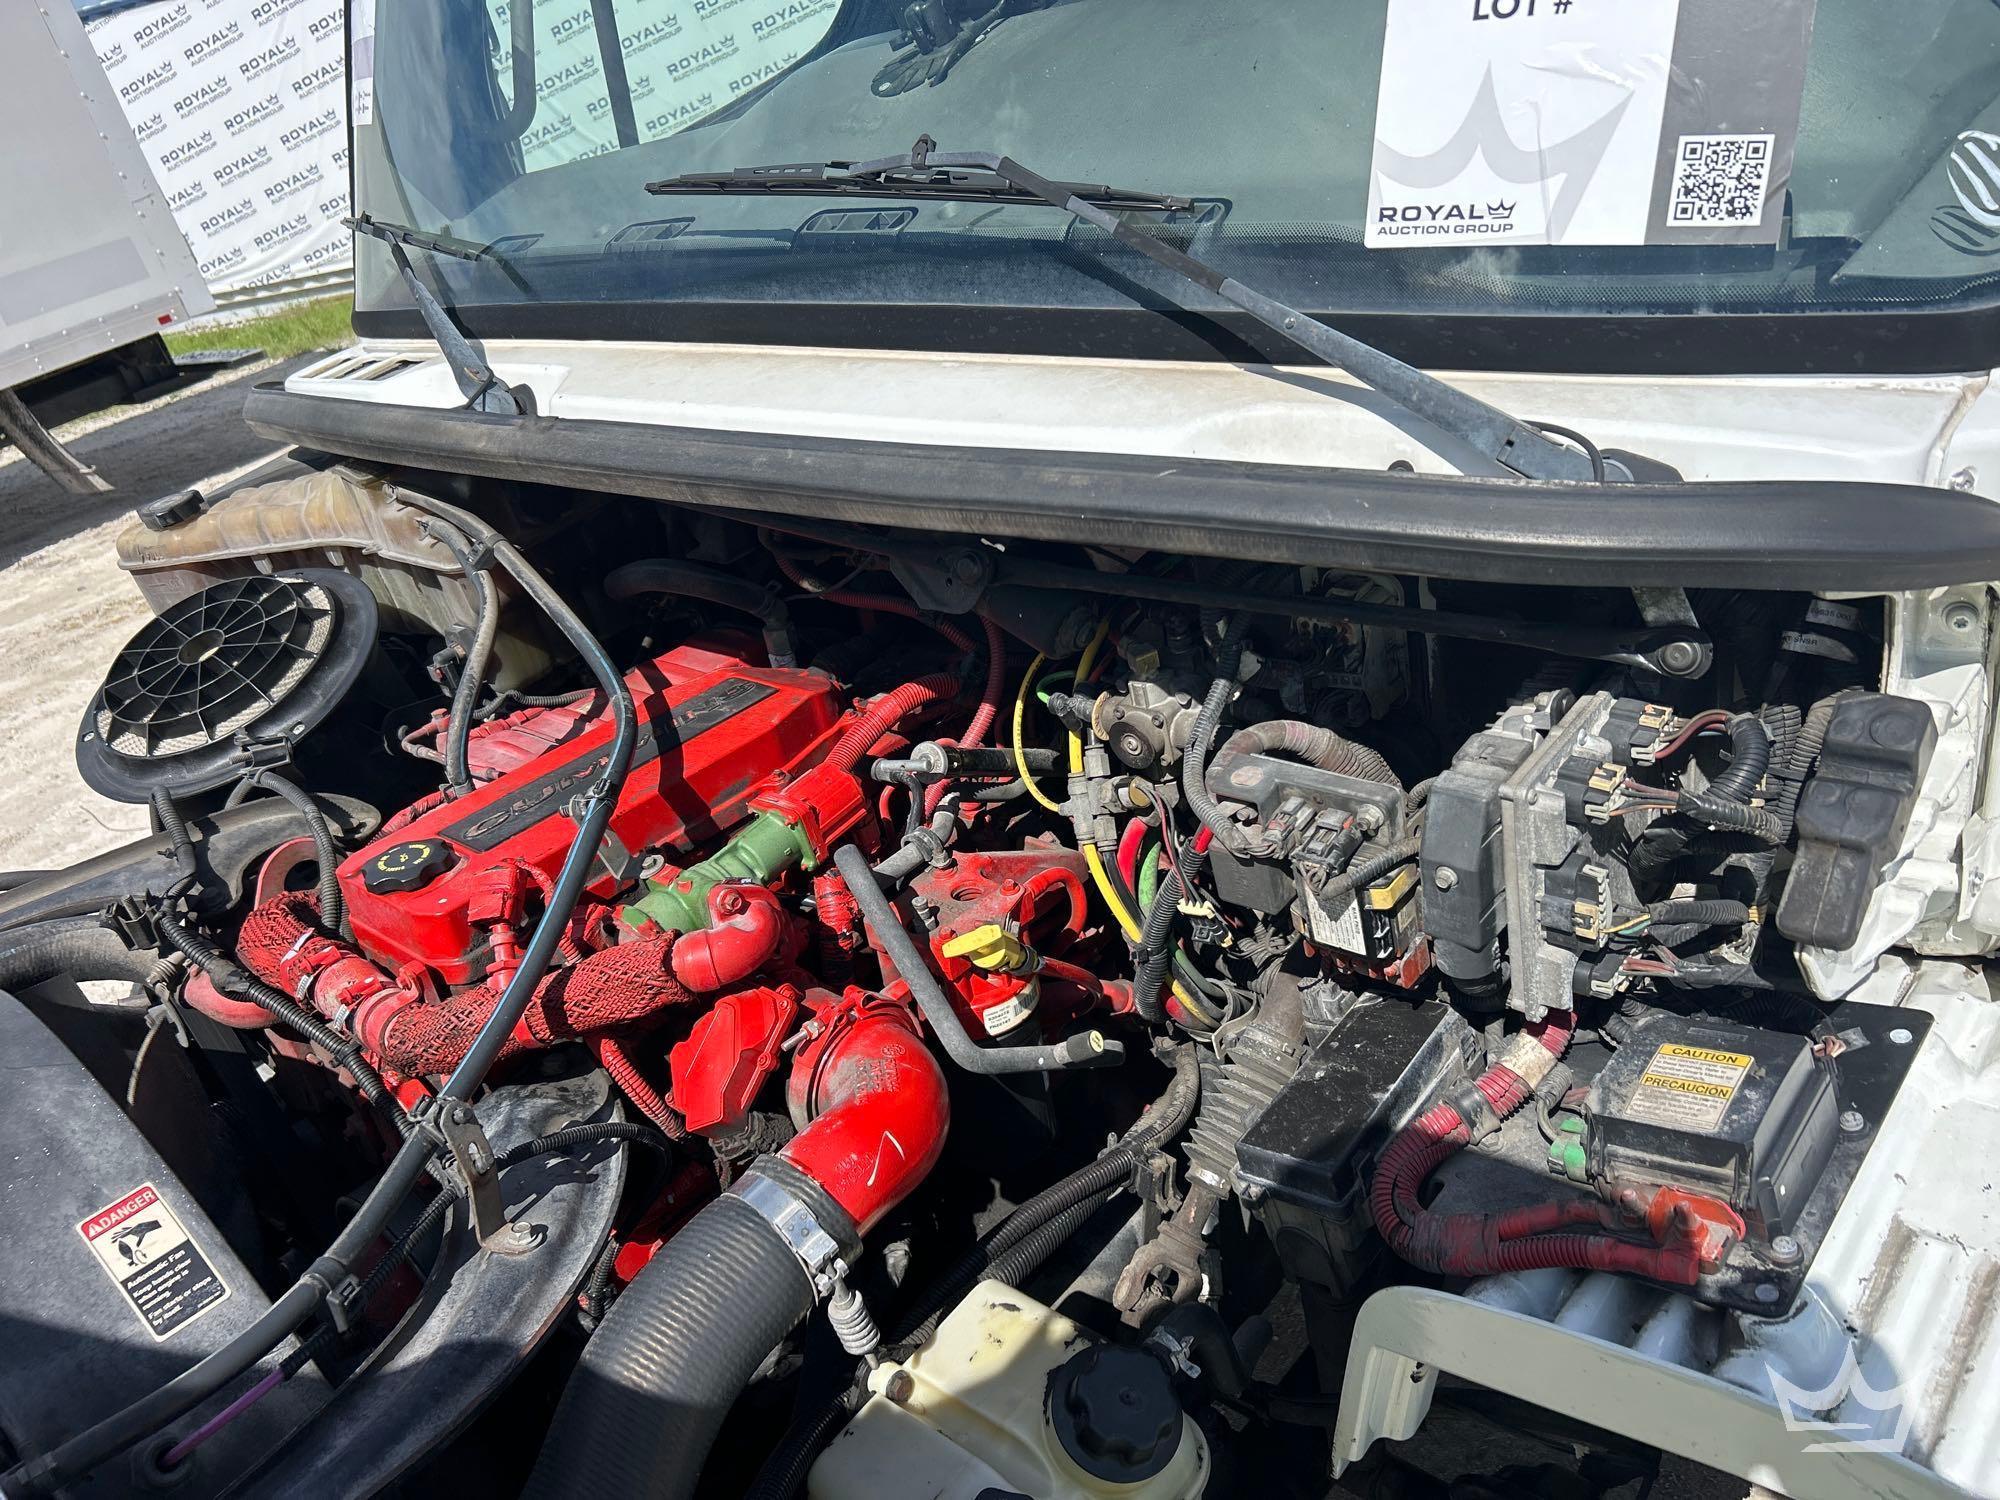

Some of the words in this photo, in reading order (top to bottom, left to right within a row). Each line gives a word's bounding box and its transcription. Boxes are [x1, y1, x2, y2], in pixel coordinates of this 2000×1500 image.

[259, 5, 288, 27] AUCTION
[308, 8, 344, 36] ROYA
[700, 1, 738, 21] AUCTION
[752, 1, 809, 34] ROYAL
[133, 12, 177, 42] ROYAL
[551, 9, 593, 38] ROYA
[557, 22, 590, 45] AUCTION
[758, 19, 796, 42] AUCTION
[140, 29, 169, 50] AUCTION
[183, 30, 229, 60] ROYAL
[621, 23, 664, 49] OYAL
[191, 46, 221, 67] AUCTION
[240, 44, 285, 75] ROYAL
[666, 44, 722, 75] ROYAL
[246, 61, 277, 82] AUCTION
[292, 63, 338, 93] ROYAL
[536, 64, 583, 93] ROYAL
[673, 60, 709, 83] AUCTION
[729, 62, 784, 93] ROYAL
[120, 69, 162, 98] ROYAL
[299, 80, 330, 100] AUCTION
[127, 86, 155, 105] AUCTION
[174, 84, 217, 113] ROYAL
[180, 100, 209, 119] AUCTION
[224, 102, 269, 130] ROYAL
[646, 102, 700, 132] ROYAL
[231, 117, 260, 137] AUCTION
[280, 117, 326, 146] ROYAL
[521, 122, 560, 147] OYAL
[160, 139, 202, 165] ROYAL
[286, 134, 317, 152] AUCTION
[569, 140, 619, 162] OYAL
[167, 154, 195, 173] AUCTION
[213, 154, 258, 181] ROYAL
[221, 170, 249, 187] AUCTION
[264, 171, 309, 199] ROYAL
[168, 188, 193, 204] YAL
[271, 188, 300, 205] AUCTION
[319, 193, 347, 214] ROY
[200, 205, 243, 232] ROYAL
[1379, 204, 1484, 222] ROYAL
[207, 222, 235, 238] AUCTION
[254, 221, 298, 247] ROYAL
[1378, 225, 1450, 236] AUCTION
[1453, 223, 1514, 234] GROUP
[261, 236, 289, 253] AUCTION
[303, 239, 348, 264] ROYAL
[200, 253, 233, 273] OYAL
[241, 270, 281, 289] OYAL
[1672, 1047, 1738, 1063] CAUTION
[100, 1191, 155, 1229] DANGER
[127, 1260, 169, 1289] Automatic
[168, 1250, 185, 1263] Fan
[151, 1270, 174, 1286] hands
[174, 1258, 191, 1272] clear
[157, 1274, 181, 1292] engine
[148, 1308, 163, 1320] Fan
[183, 1288, 191, 1297] or
[152, 1317, 163, 1327] by
